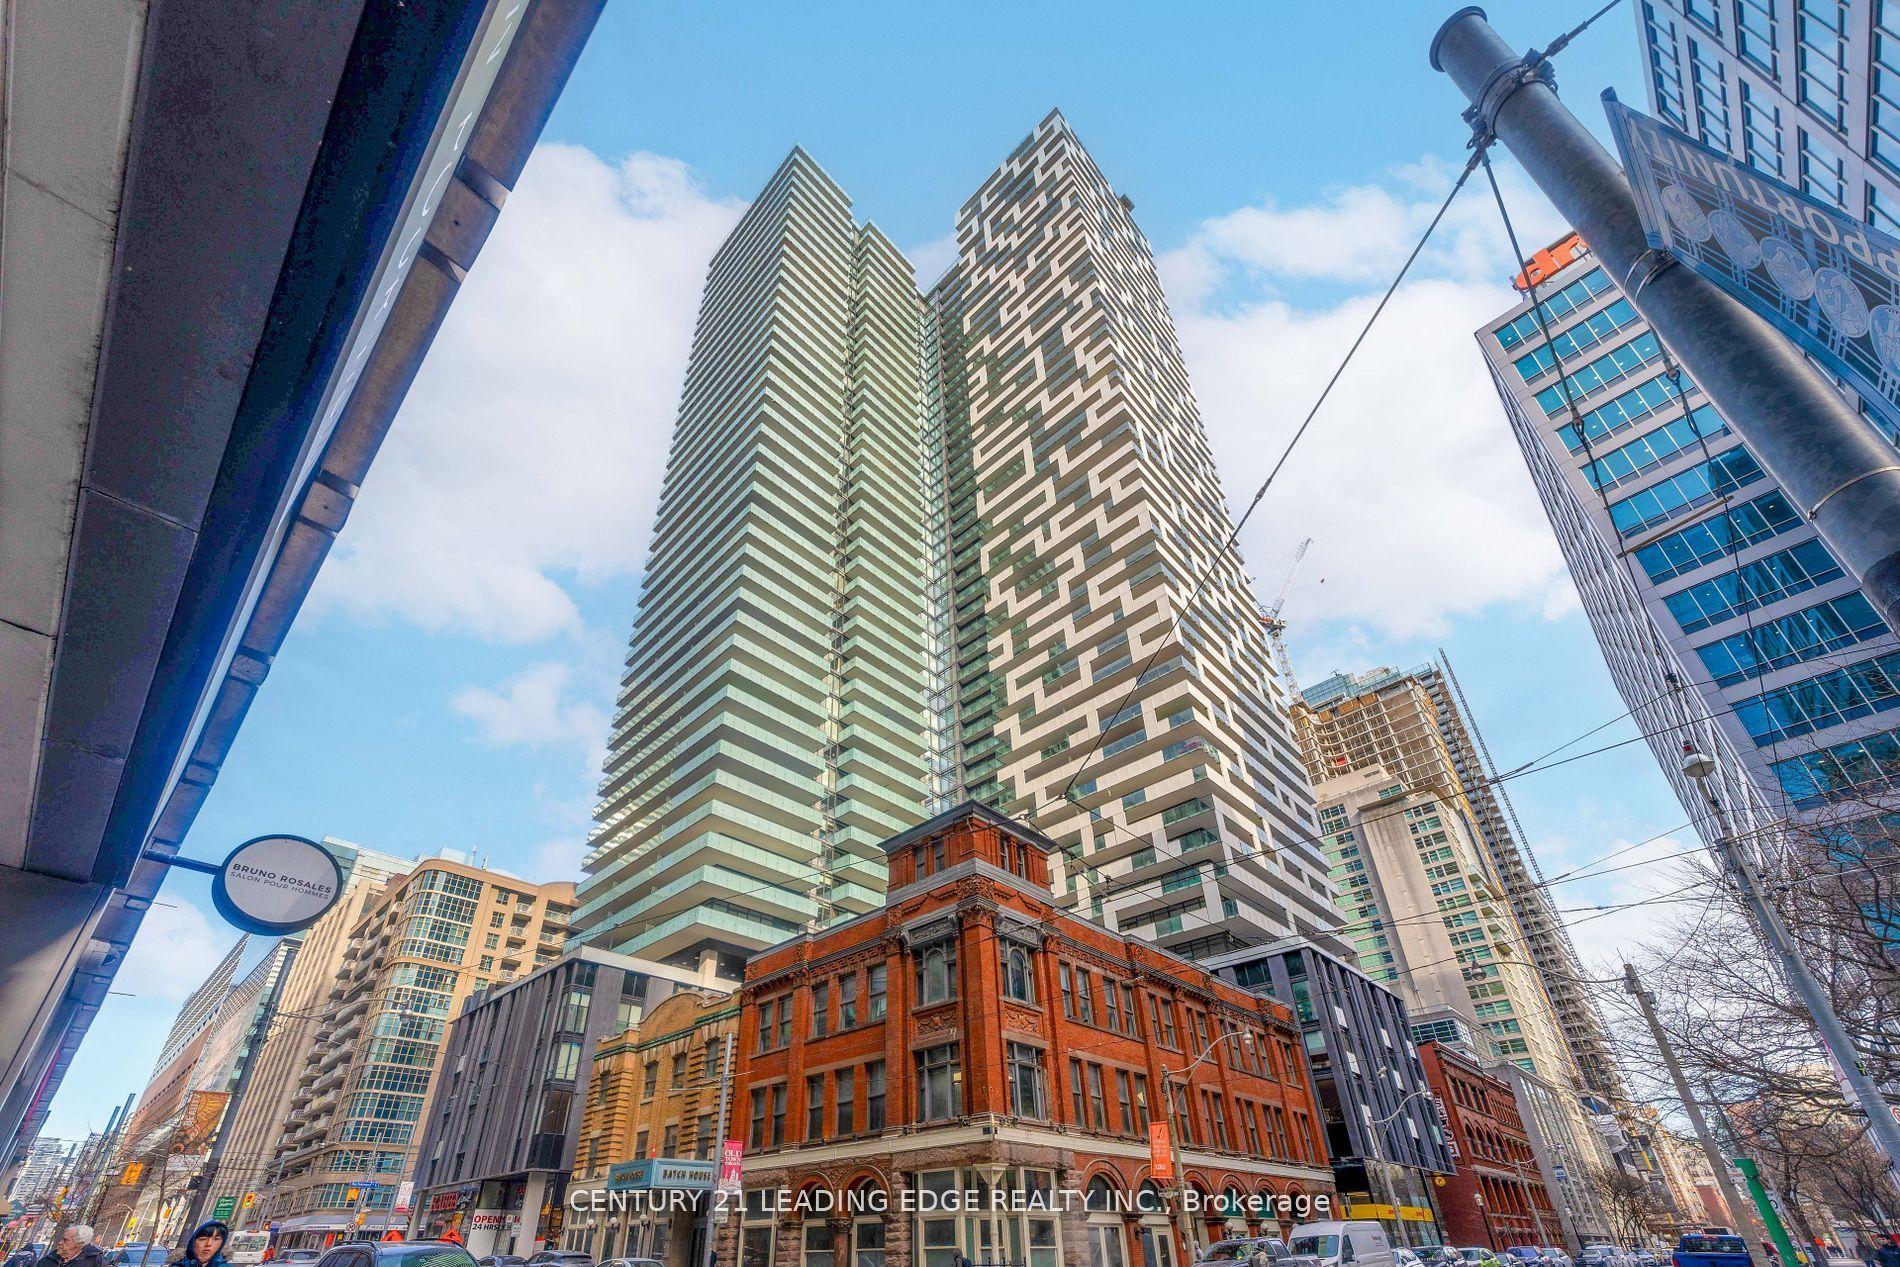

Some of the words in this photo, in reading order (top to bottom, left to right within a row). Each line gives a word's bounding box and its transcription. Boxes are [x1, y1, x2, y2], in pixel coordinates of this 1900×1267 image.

[232, 863, 277, 880] BRUNO
[279, 875, 332, 895] ROSALES
[230, 871, 261, 882] SALON
[263, 880, 289, 889] POUR
[291, 886, 329, 900] HOMMES
[724, 1149, 742, 1157] OLD
[688, 1169, 712, 1181] HOUSE
[473, 1214, 500, 1224] OPEN
[472, 1223, 482, 1231] 24
